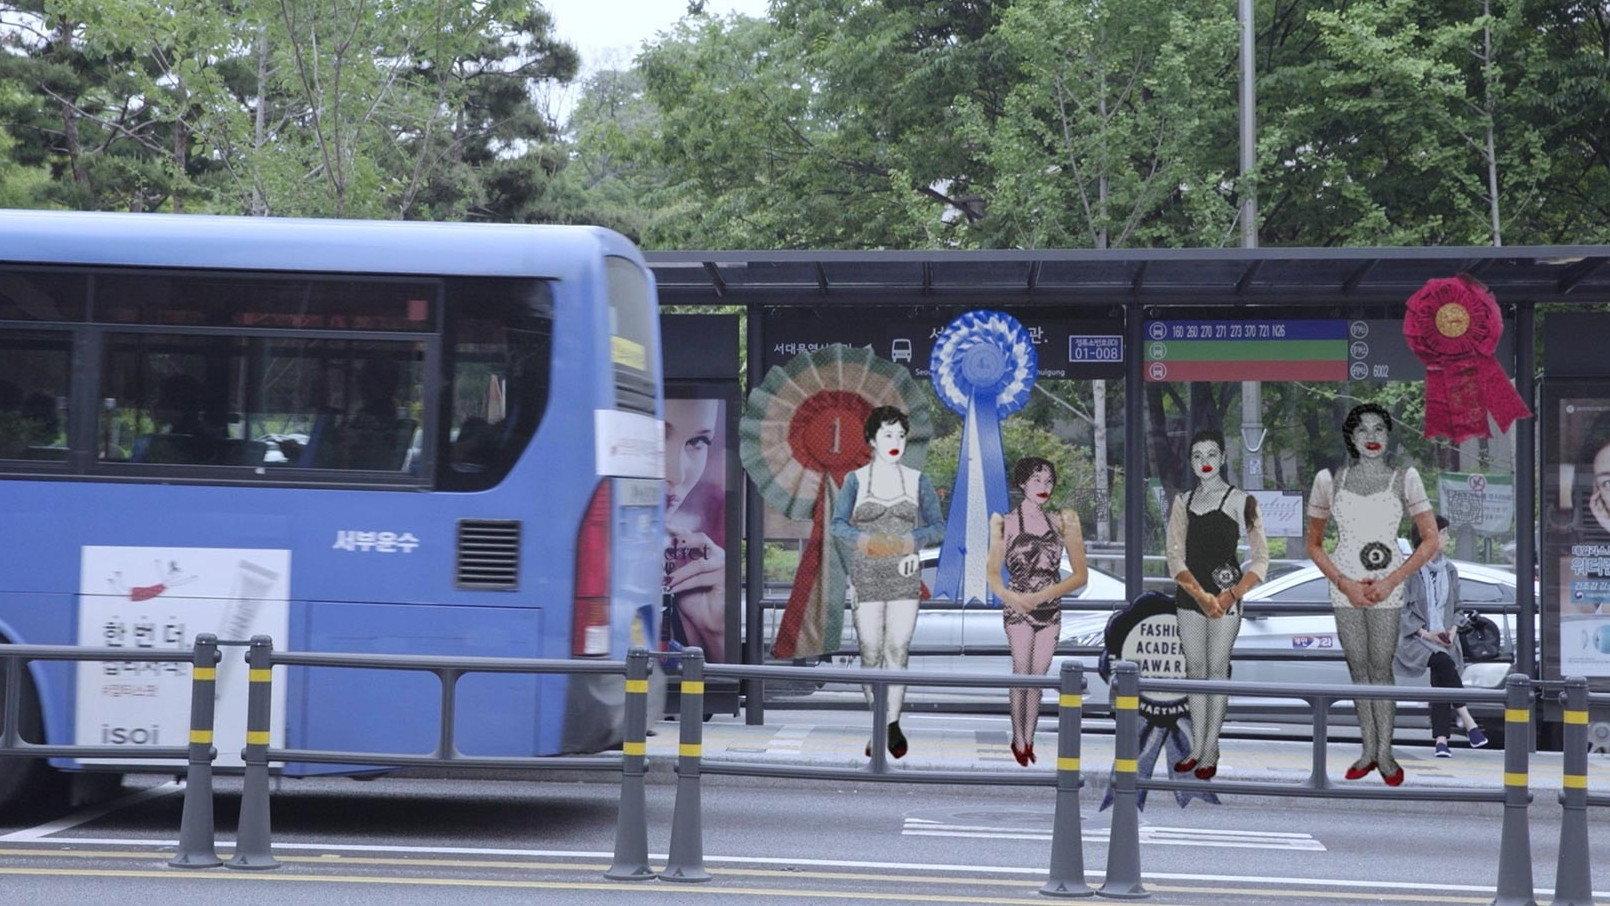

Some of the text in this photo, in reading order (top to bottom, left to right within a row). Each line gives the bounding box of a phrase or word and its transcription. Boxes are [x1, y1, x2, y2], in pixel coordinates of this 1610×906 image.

[1172, 324, 1184, 338] 160
[1186, 324, 1199, 338] 260
[1200, 324, 1212, 338] 270
[1216, 324, 1227, 338] 271
[1230, 324, 1242, 338] 273
[1244, 324, 1257, 338] 370
[1272, 324, 1286, 338] N26
[1075, 347, 1118, 359] 01-008
[1373, 364, 1389, 378] 6002
[332, 530, 420, 554] 서부운수
[1141, 659, 1182, 673] AWAR
[101, 723, 159, 744] isoi
